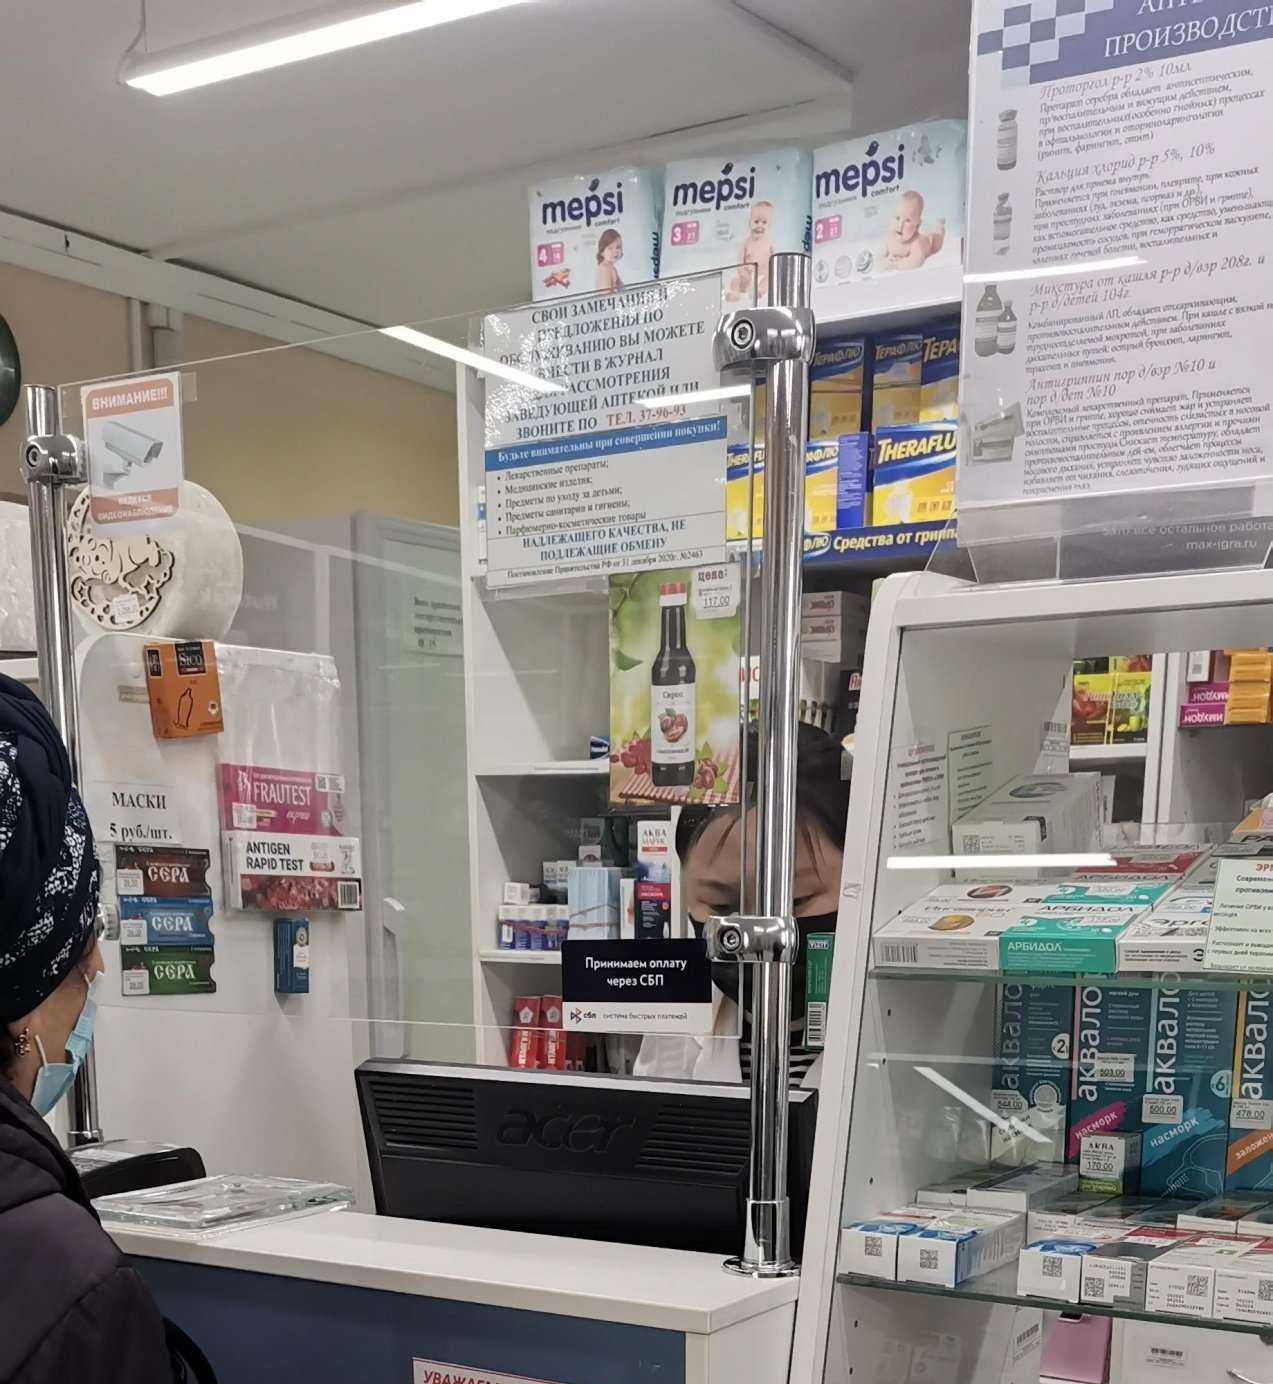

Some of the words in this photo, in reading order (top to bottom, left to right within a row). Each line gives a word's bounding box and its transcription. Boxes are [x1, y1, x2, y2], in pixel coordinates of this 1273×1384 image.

[815, 143, 904, 198] mepsi
[673, 165, 755, 210] mepsi
[542, 181, 623, 228] mepsi
[532, 306, 568, 324] СВОИ
[620, 334, 639, 347] ВЫ
[644, 321, 705, 342] МОЖЕТЕ
[594, 358, 602, 371] В
[605, 348, 663, 370] ЖУРНАЛ
[92, 387, 168, 410] ВНИМАНИЕ!!!
[579, 417, 597, 430] ПО
[607, 408, 635, 427] ТЕЛ.
[639, 404, 687, 422] 37-96-93
[522, 530, 607, 549] НАДЛЕЖАЩЕГО
[671, 519, 686, 531] НЕ
[833, 533, 893, 551] Средства
[896, 532, 913, 545] от
[540, 543, 618, 561] ПОДЛЕЖАЩИЕ
[620, 538, 666, 553] ОБМЕНУ
[112, 792, 167, 810] МАСКИ
[254, 784, 312, 805] FRAUTEST
[109, 823, 118, 837] 5
[121, 823, 173, 842] руб./шт.
[246, 841, 291, 855] ANTIGEN
[246, 857, 276, 870] RAPID
[279, 859, 304, 871] TEST
[1007, 941, 1063, 952] АРБИДОЛ
[585, 956, 647, 971] Принимаем
[650, 958, 687, 972] оплату
[606, 976, 638, 988] через
[640, 974, 664, 987] СБП
[495, 1107, 639, 1154] acer
[1151, 1117, 1200, 1147] насморк
